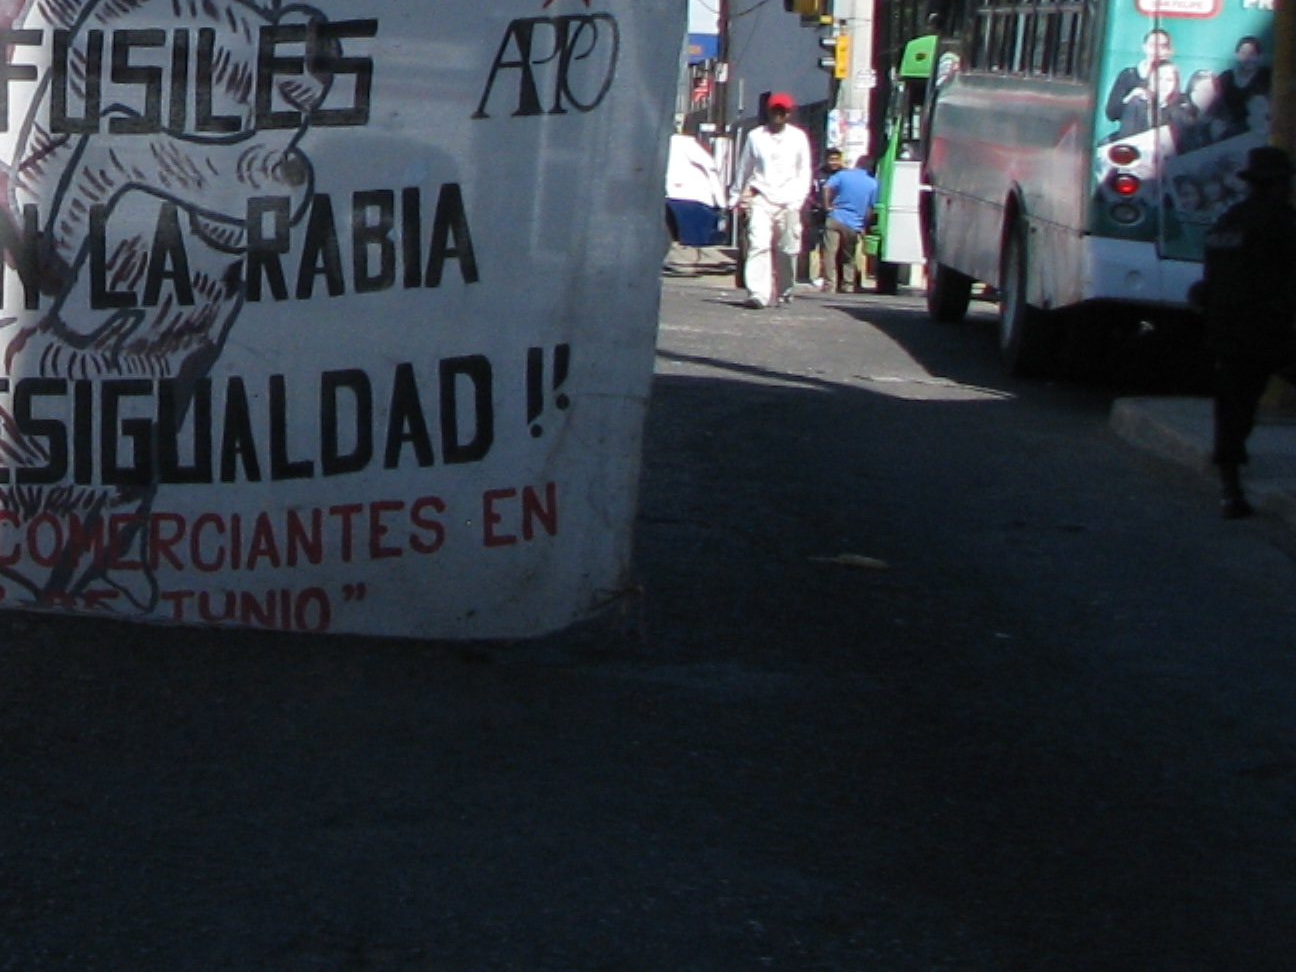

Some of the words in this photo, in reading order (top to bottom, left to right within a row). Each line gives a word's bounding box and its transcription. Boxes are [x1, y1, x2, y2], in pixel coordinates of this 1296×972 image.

[89, 200, 195, 310] LA
[245, 182, 480, 303] RABIA
[482, 481, 558, 548] EN
